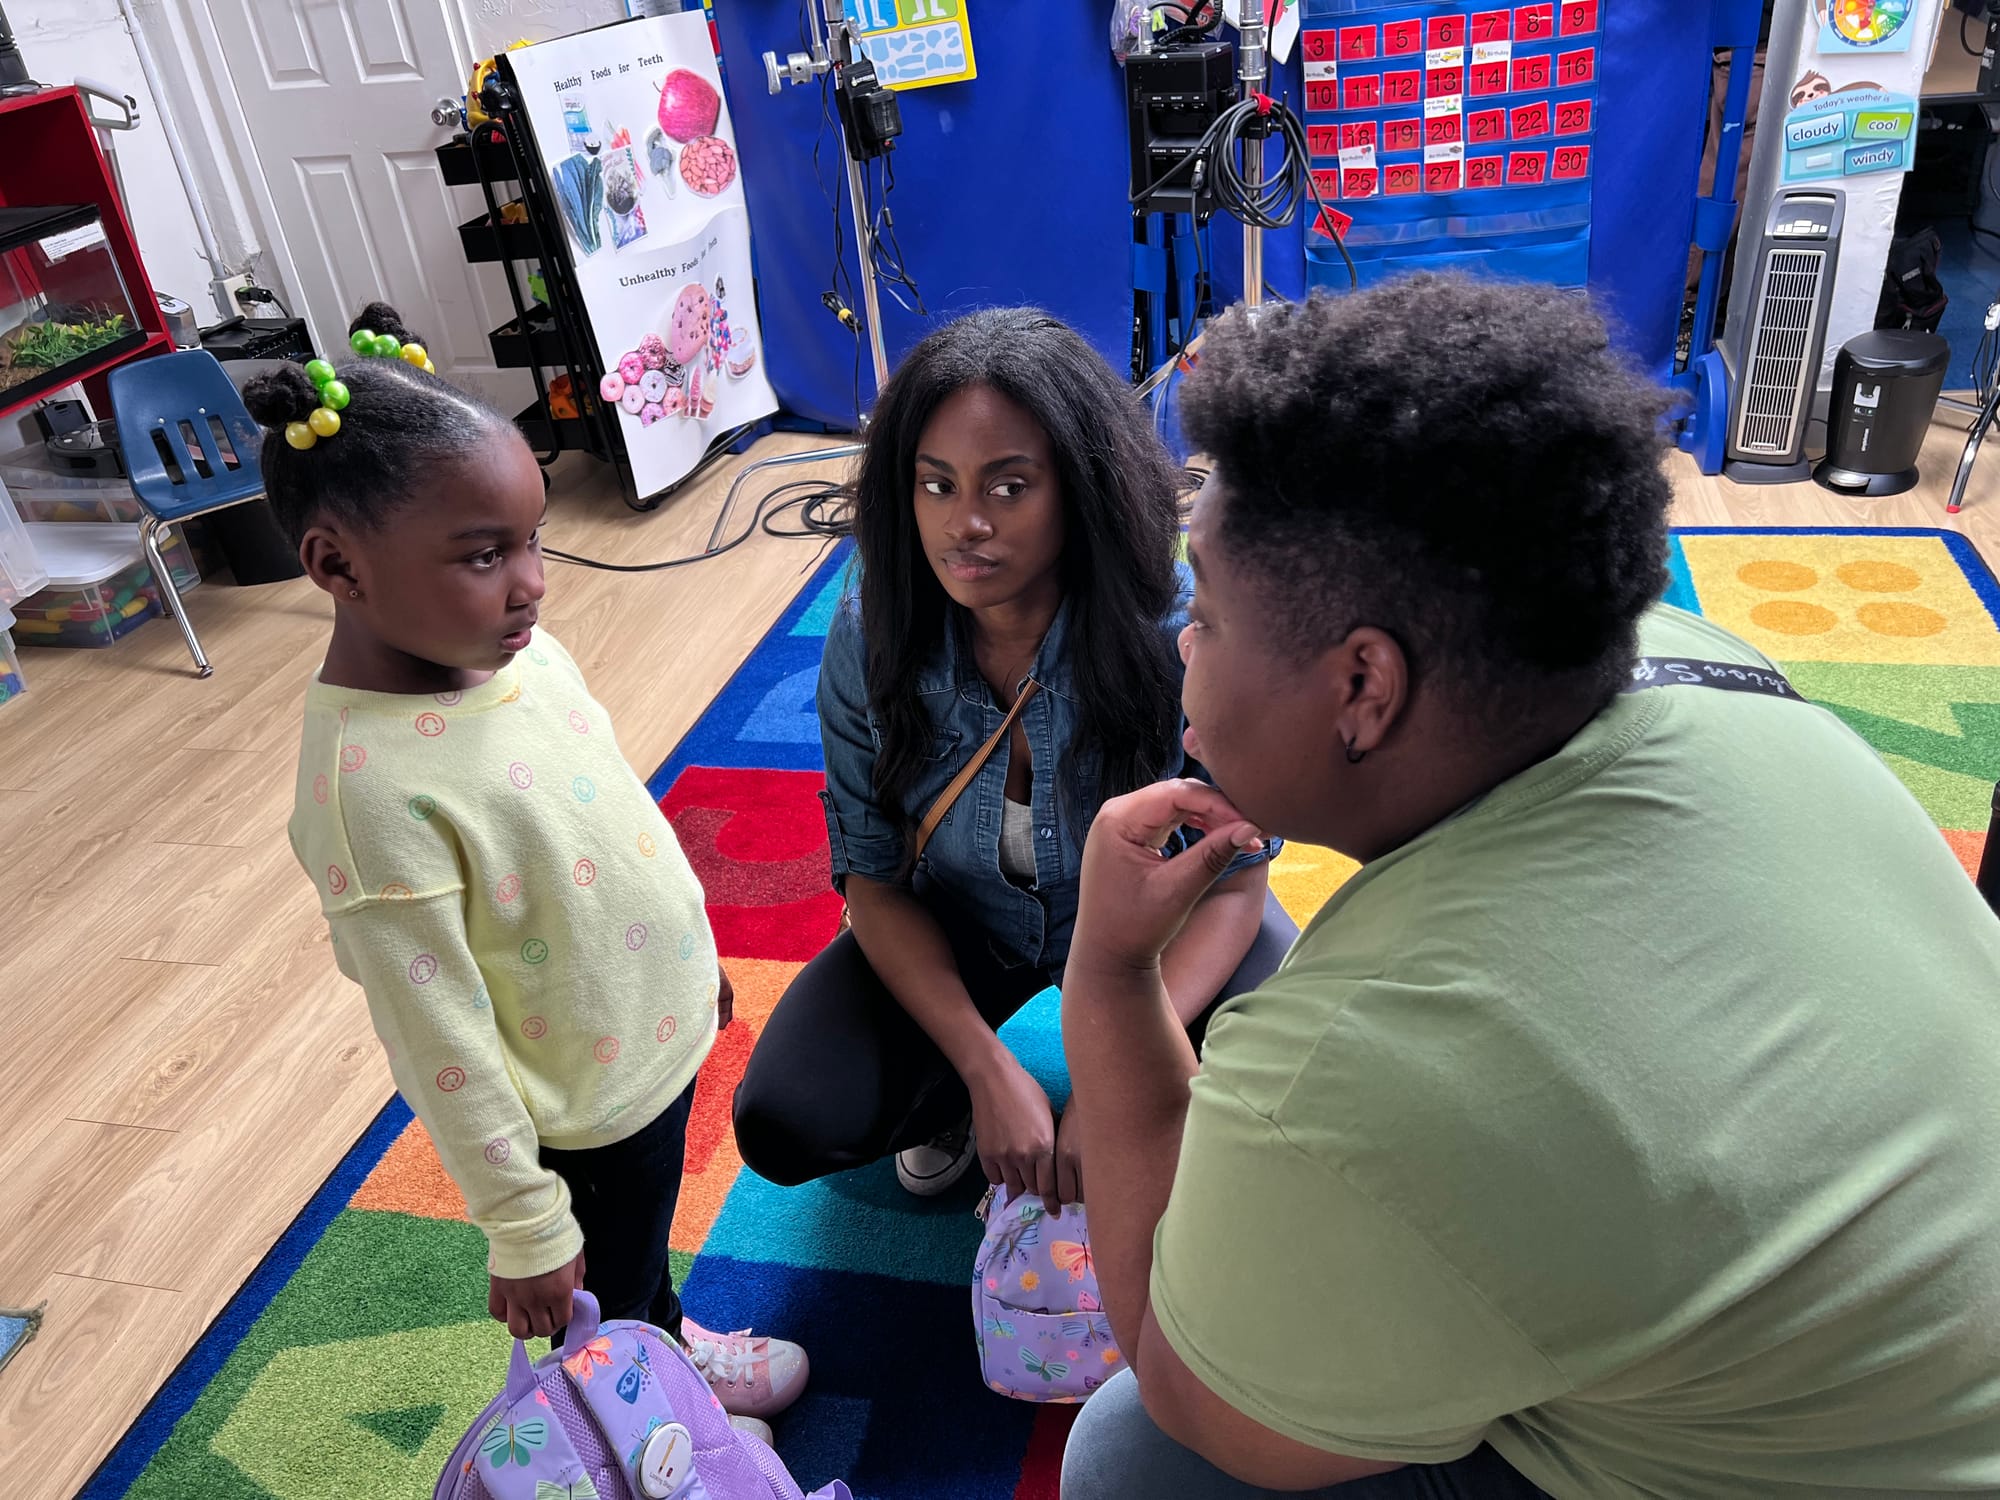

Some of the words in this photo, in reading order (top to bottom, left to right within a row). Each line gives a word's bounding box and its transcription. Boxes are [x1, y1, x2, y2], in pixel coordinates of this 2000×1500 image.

[1313, 38, 1324, 56] 3
[1351, 34, 1363, 52] 4
[1397, 30, 1408, 48] 5
[1440, 23, 1452, 42] 6
[1485, 17, 1496, 38] 7
[1527, 13, 1539, 33] 8
[1573, 7, 1585, 27] 9
[554, 76, 582, 92] Healthy
[591, 66, 612, 81] Foods
[618, 63, 630, 74] for
[637, 54, 663, 67] Teeth
[1312, 86, 1332, 105] 10
[1353, 83, 1370, 102] 11
[1390, 78, 1413, 97] 12
[1433, 72, 1456, 92] 13
[1476, 68, 1501, 89] 14
[1520, 63, 1543, 84] 15
[1564, 57, 1587, 78] 16
[1814, 98, 1844, 111] Today's
[1846, 94, 1882, 103] weather
[1883, 94, 1890, 102] is
[1313, 132, 1332, 150] 17
[1348, 129, 1370, 147] 18
[1391, 124, 1413, 144] 19
[1431, 121, 1455, 141] 20
[1476, 116, 1497, 136] 21
[1518, 110, 1542, 132] 22
[1561, 108, 1584, 128] 23
[1793, 122, 1839, 141] cloudy
[1868, 118, 1898, 130] cool
[1348, 173, 1371, 191] 25
[1390, 169, 1414, 187] 26
[1430, 166, 1453, 185] 27
[1471, 161, 1495, 180] 28
[1514, 157, 1539, 176] 29
[1558, 152, 1582, 171] 30
[1853, 149, 1894, 166] windy
[619, 267, 677, 287] Unhealthy
[681, 257, 699, 273] Foods
